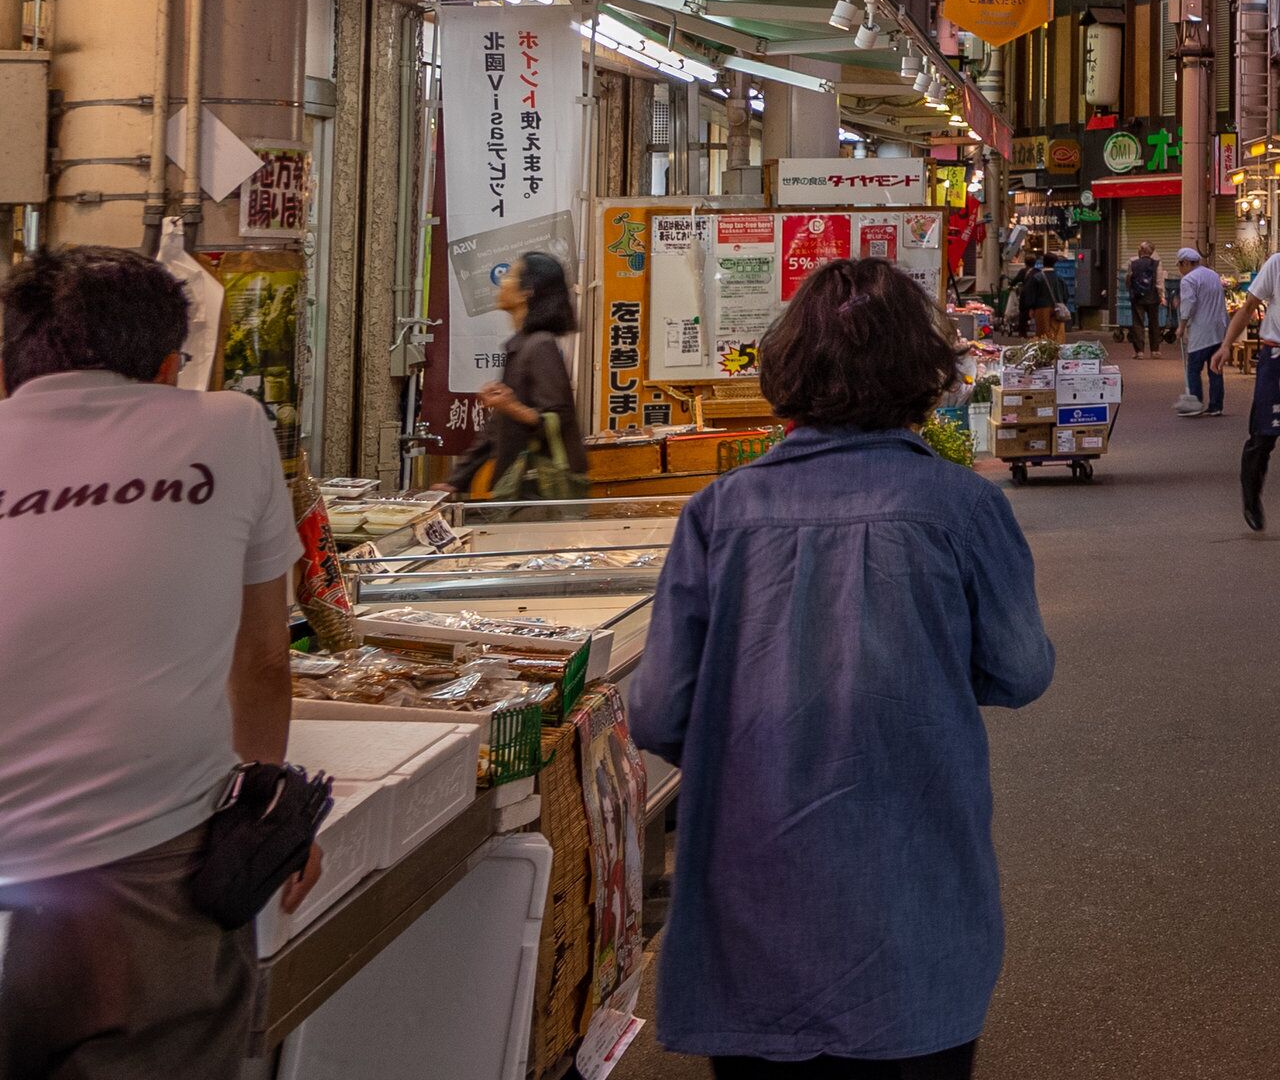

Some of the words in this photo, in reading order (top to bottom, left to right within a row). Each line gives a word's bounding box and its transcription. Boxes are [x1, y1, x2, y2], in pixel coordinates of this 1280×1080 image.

[782, 176, 827, 186] 世界の食品
[827, 174, 920, 188] ダイヤモンド
